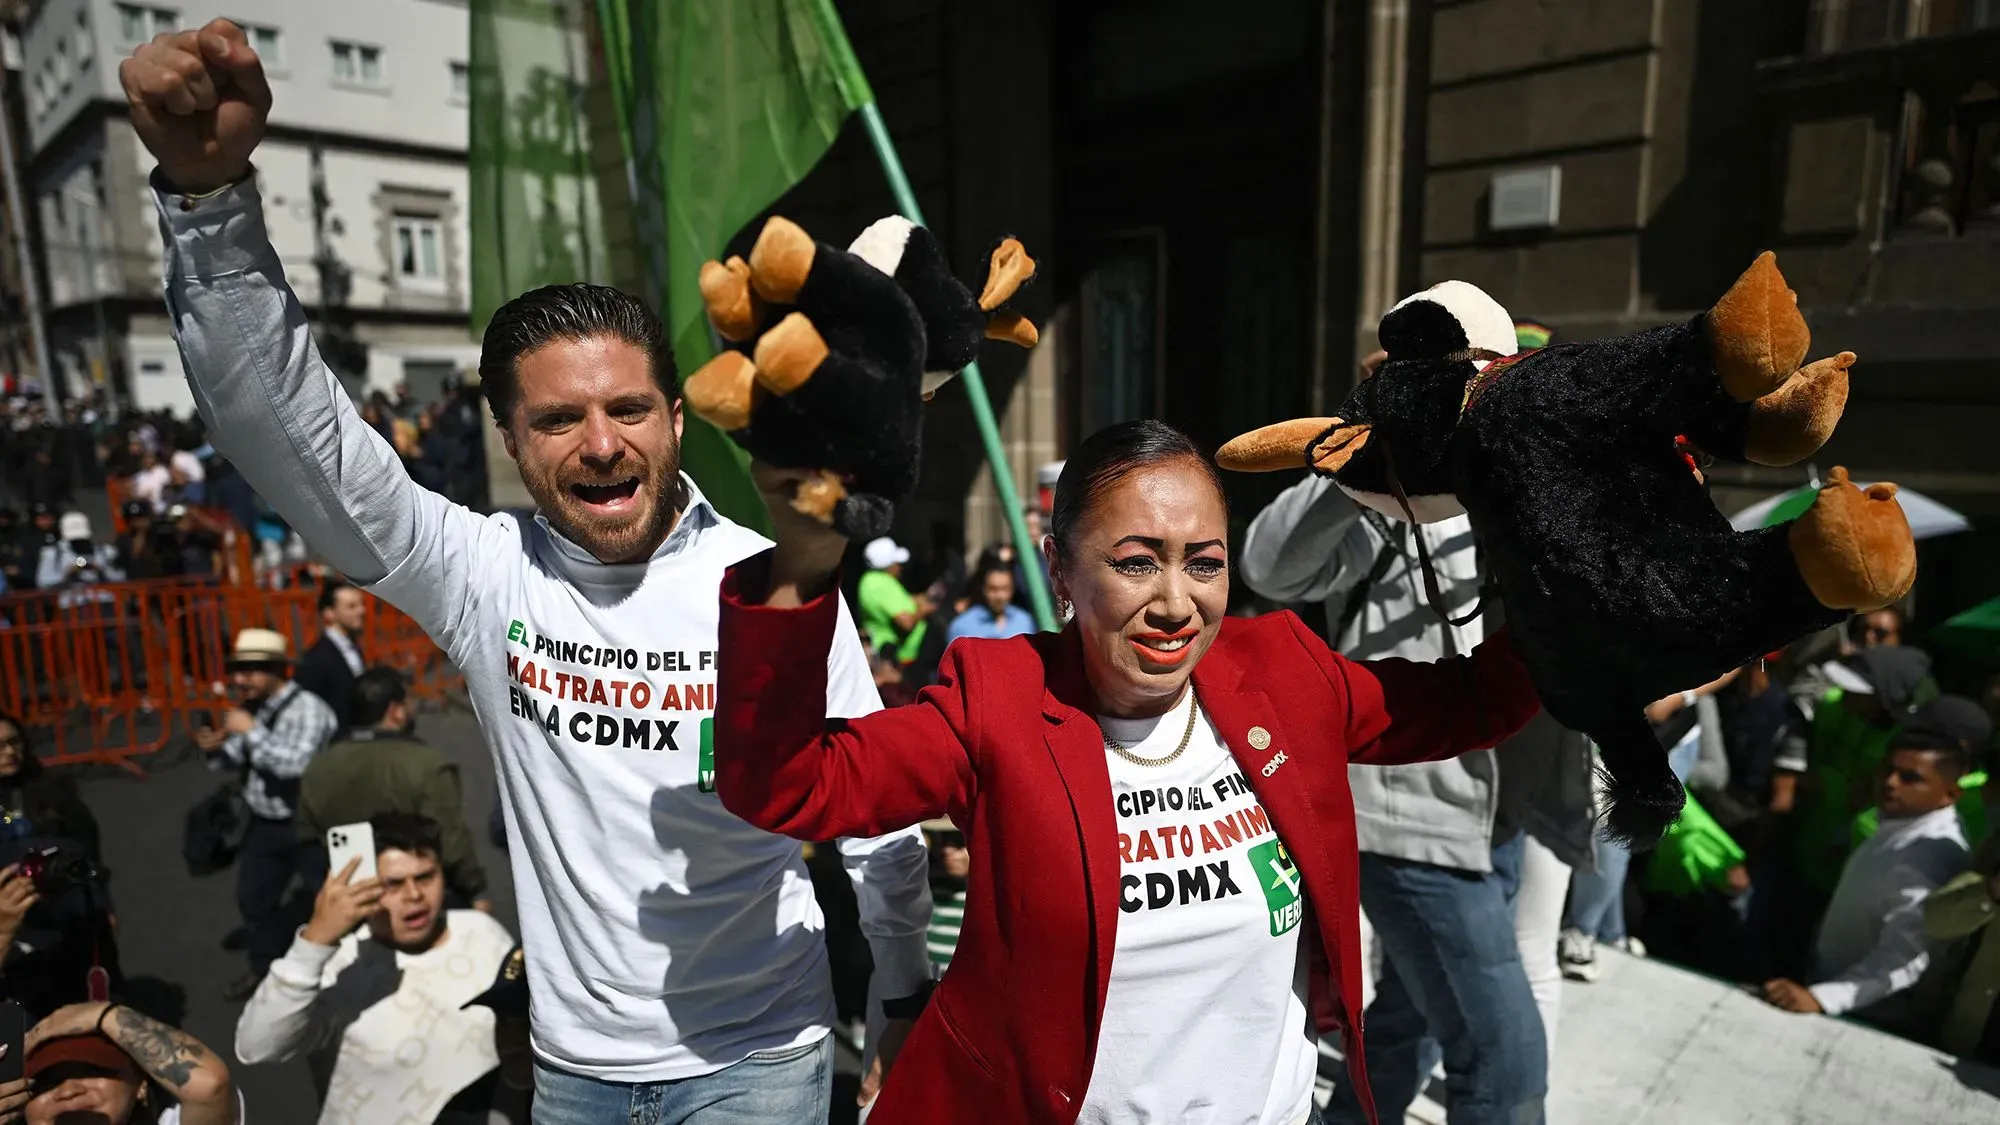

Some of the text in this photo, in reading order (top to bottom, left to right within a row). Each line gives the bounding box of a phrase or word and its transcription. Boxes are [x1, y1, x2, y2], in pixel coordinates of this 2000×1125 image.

[507, 619, 529, 648] EL
[533, 634, 638, 670] PRINCIPIO
[646, 650, 691, 671] DEL
[506, 650, 714, 711] MALTRATO ANI
[509, 685, 533, 721] EN
[569, 711, 680, 751] CDMX
[1261, 749, 1289, 777] CDMX
[1117, 786, 1184, 818] CIPIO
[1187, 786, 1213, 810] DEL
[1118, 804, 1271, 864] RATO ANIM
[1118, 860, 1242, 914] CDMX
